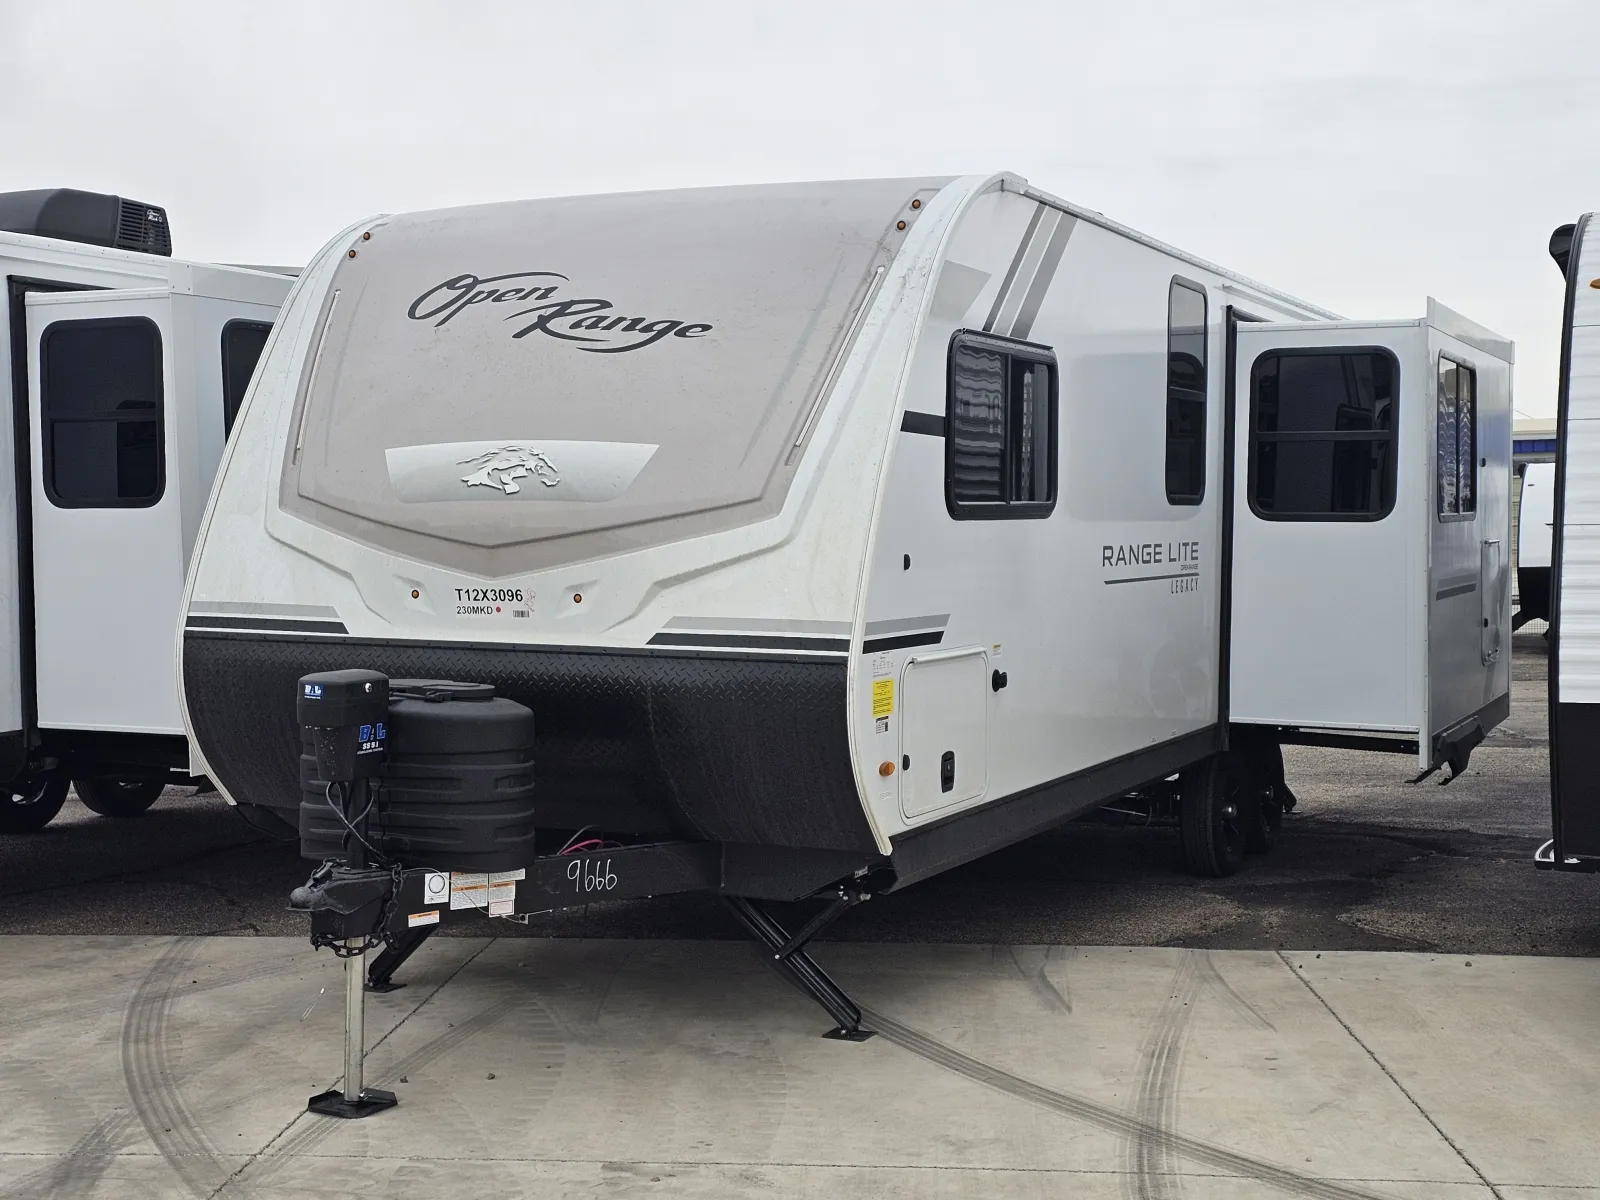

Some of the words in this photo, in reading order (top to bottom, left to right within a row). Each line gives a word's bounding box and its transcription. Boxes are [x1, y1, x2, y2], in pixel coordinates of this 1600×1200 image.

[407, 271, 570, 328] Open
[503, 298, 714, 354] Range
[1102, 543, 1163, 567] RANGE
[1168, 541, 1199, 563] LITE
[454, 588, 524, 602] T12X3096
[1171, 578, 1198, 594] LEGACY
[456, 606, 494, 615] 230MKD
[567, 858, 618, 893] 9666
